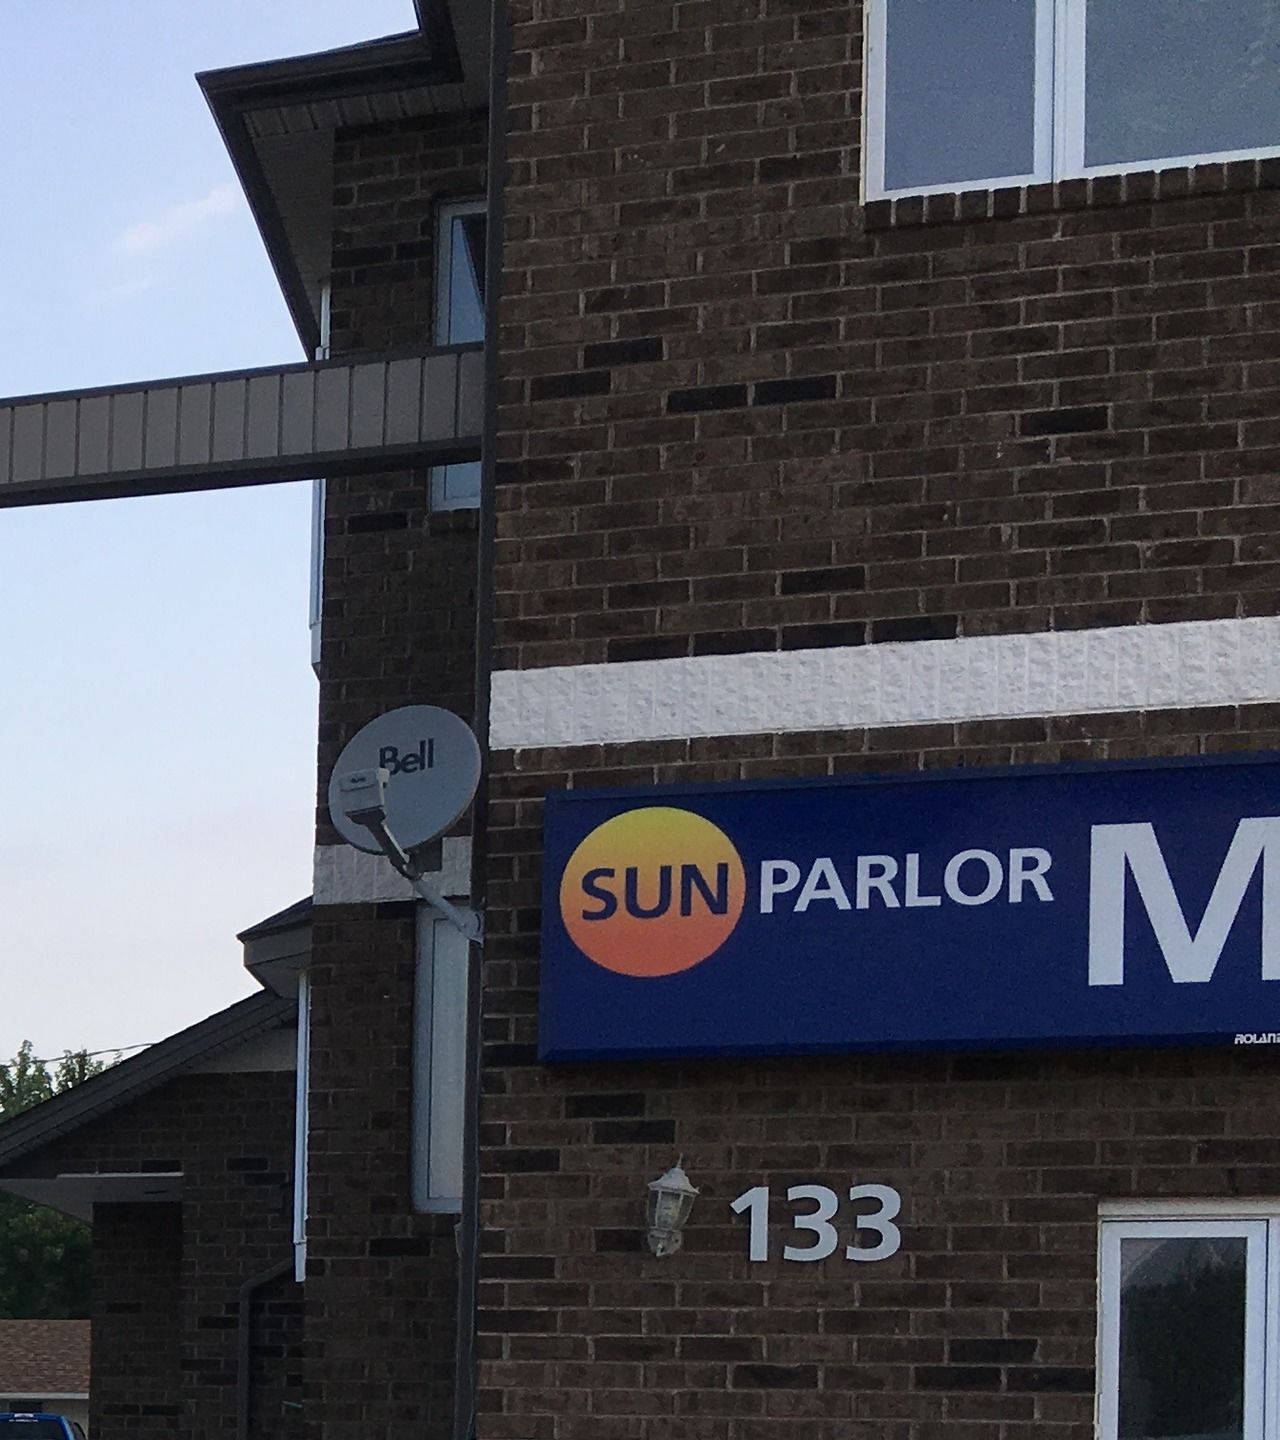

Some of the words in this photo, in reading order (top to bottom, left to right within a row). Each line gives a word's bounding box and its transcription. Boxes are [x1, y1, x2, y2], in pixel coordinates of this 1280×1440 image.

[379, 738, 434, 776] Bell
[582, 863, 728, 920] SUN
[760, 848, 1054, 913] PARLOR
[1088, 816, 1280, 986] M
[730, 1184, 901, 1261] 133
